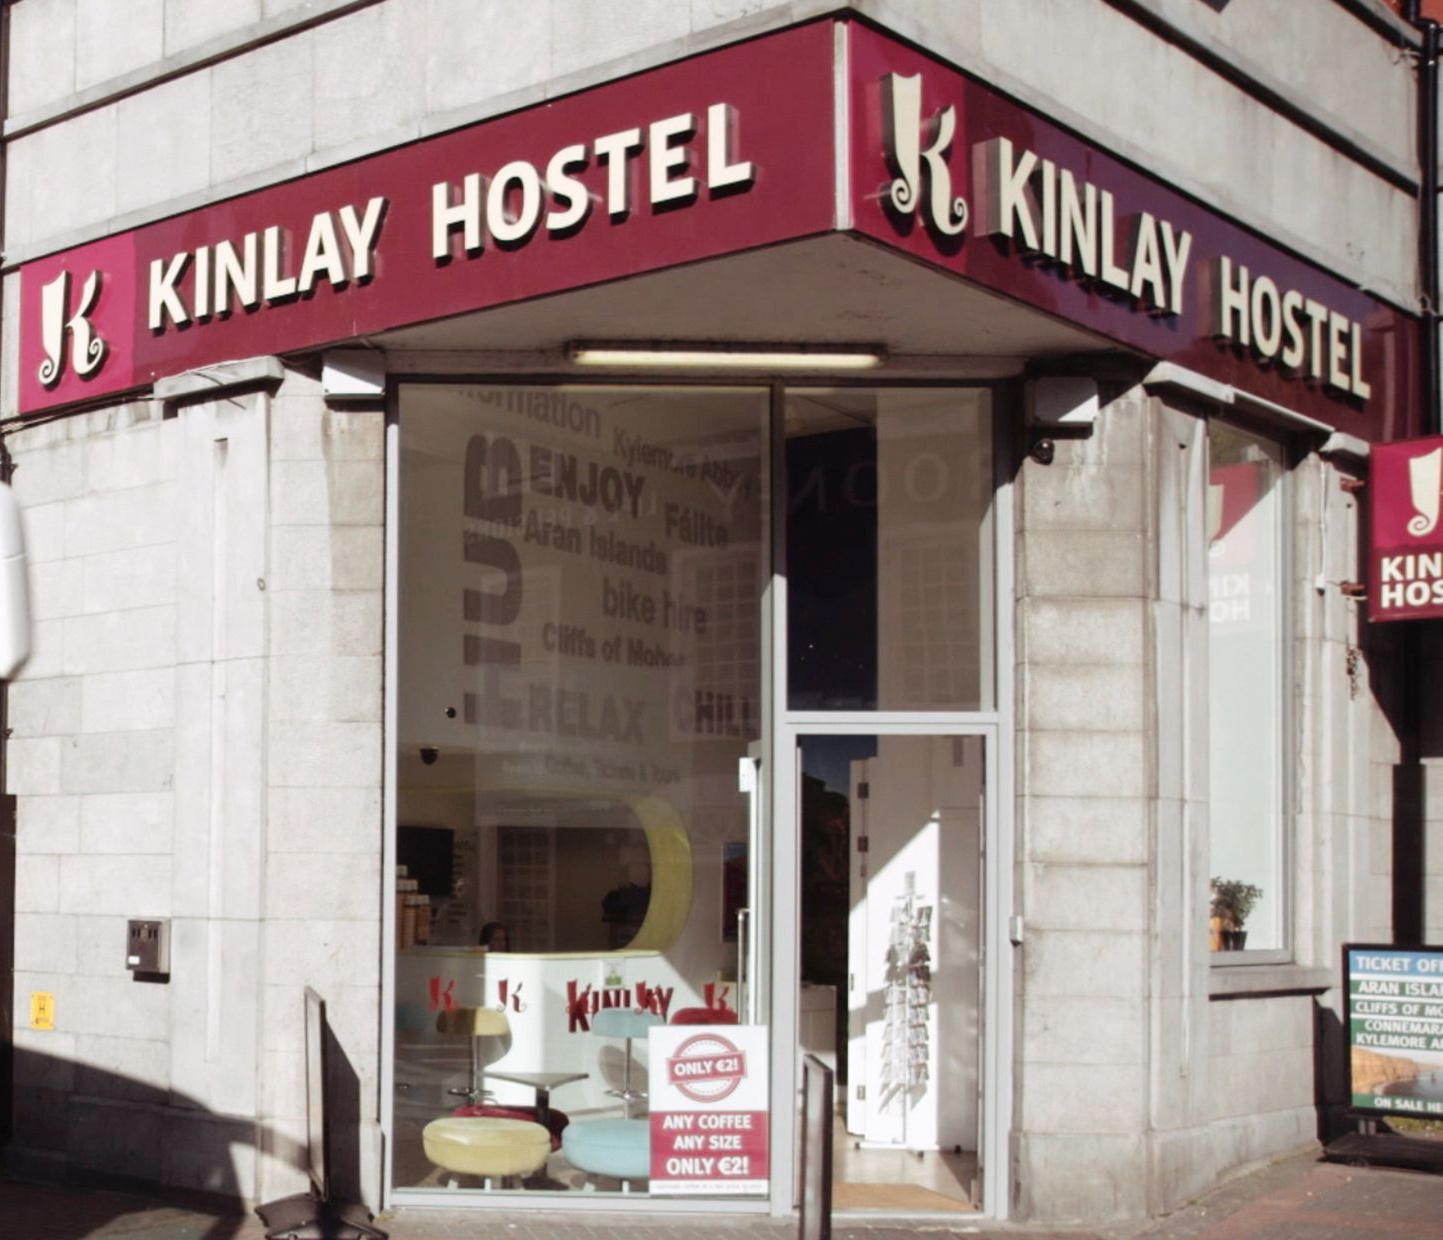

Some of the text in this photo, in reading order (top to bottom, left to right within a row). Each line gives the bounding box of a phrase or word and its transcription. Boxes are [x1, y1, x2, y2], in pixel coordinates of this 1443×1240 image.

[147, 102, 753, 330] KINLAY HOSTEL
[999, 136, 1372, 400] KINLAY HOSTEL
[529, 444, 645, 519] ENJOY
[524, 509, 582, 555] Aran
[590, 524, 669, 575] Islands
[604, 574, 656, 625] bike
[542, 621, 596, 660] Cliffs
[602, 635, 622, 664] of
[528, 683, 645, 745] RELAX
[1356, 956, 1411, 972] TICKET
[1359, 981, 1399, 995] ARAN
[1356, 1002, 1397, 1015] CLIFFS
[1402, 1004, 1420, 1016] OF
[1356, 1033, 1427, 1049] KYLEMORE
[674, 1057, 740, 1077] ONLY €2!
[1374, 1097, 1391, 1109] ON
[1396, 1099, 1423, 1111] SALE
[662, 1114, 752, 1130] ANY COFFEE
[673, 1135, 741, 1150] ANY SIZE
[666, 1156, 749, 1175] ONLY €2!
